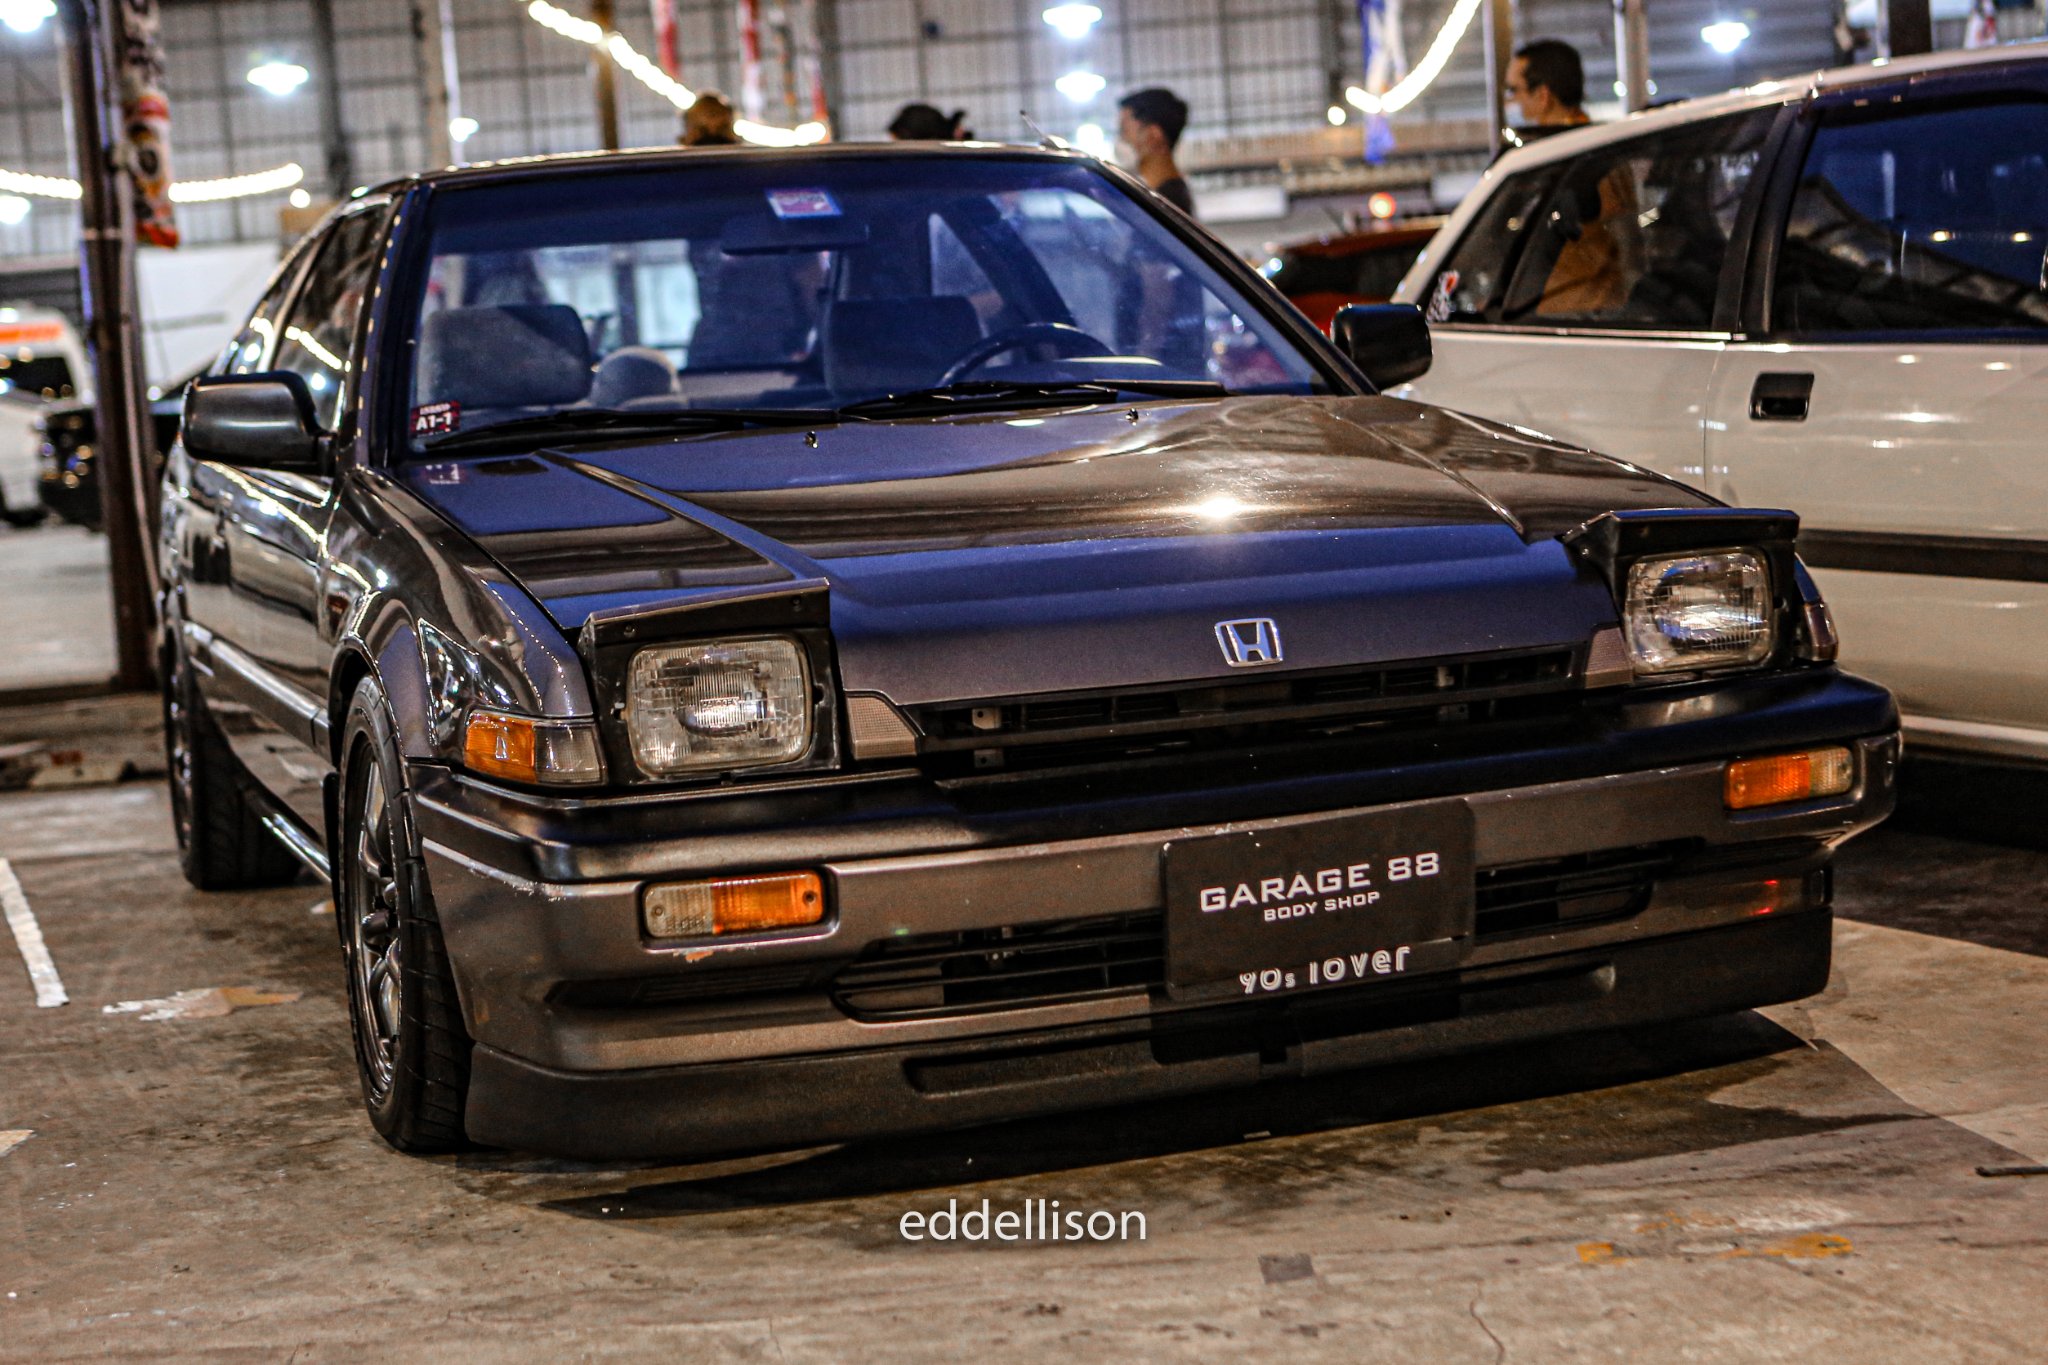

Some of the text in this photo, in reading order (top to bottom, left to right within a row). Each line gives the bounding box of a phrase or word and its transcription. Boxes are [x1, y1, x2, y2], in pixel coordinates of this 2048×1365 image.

[1200, 852, 1440, 913] GARAGE 88
[1263, 891, 1380, 922] BODY SHOP
[1239, 968, 1296, 994] 90s
